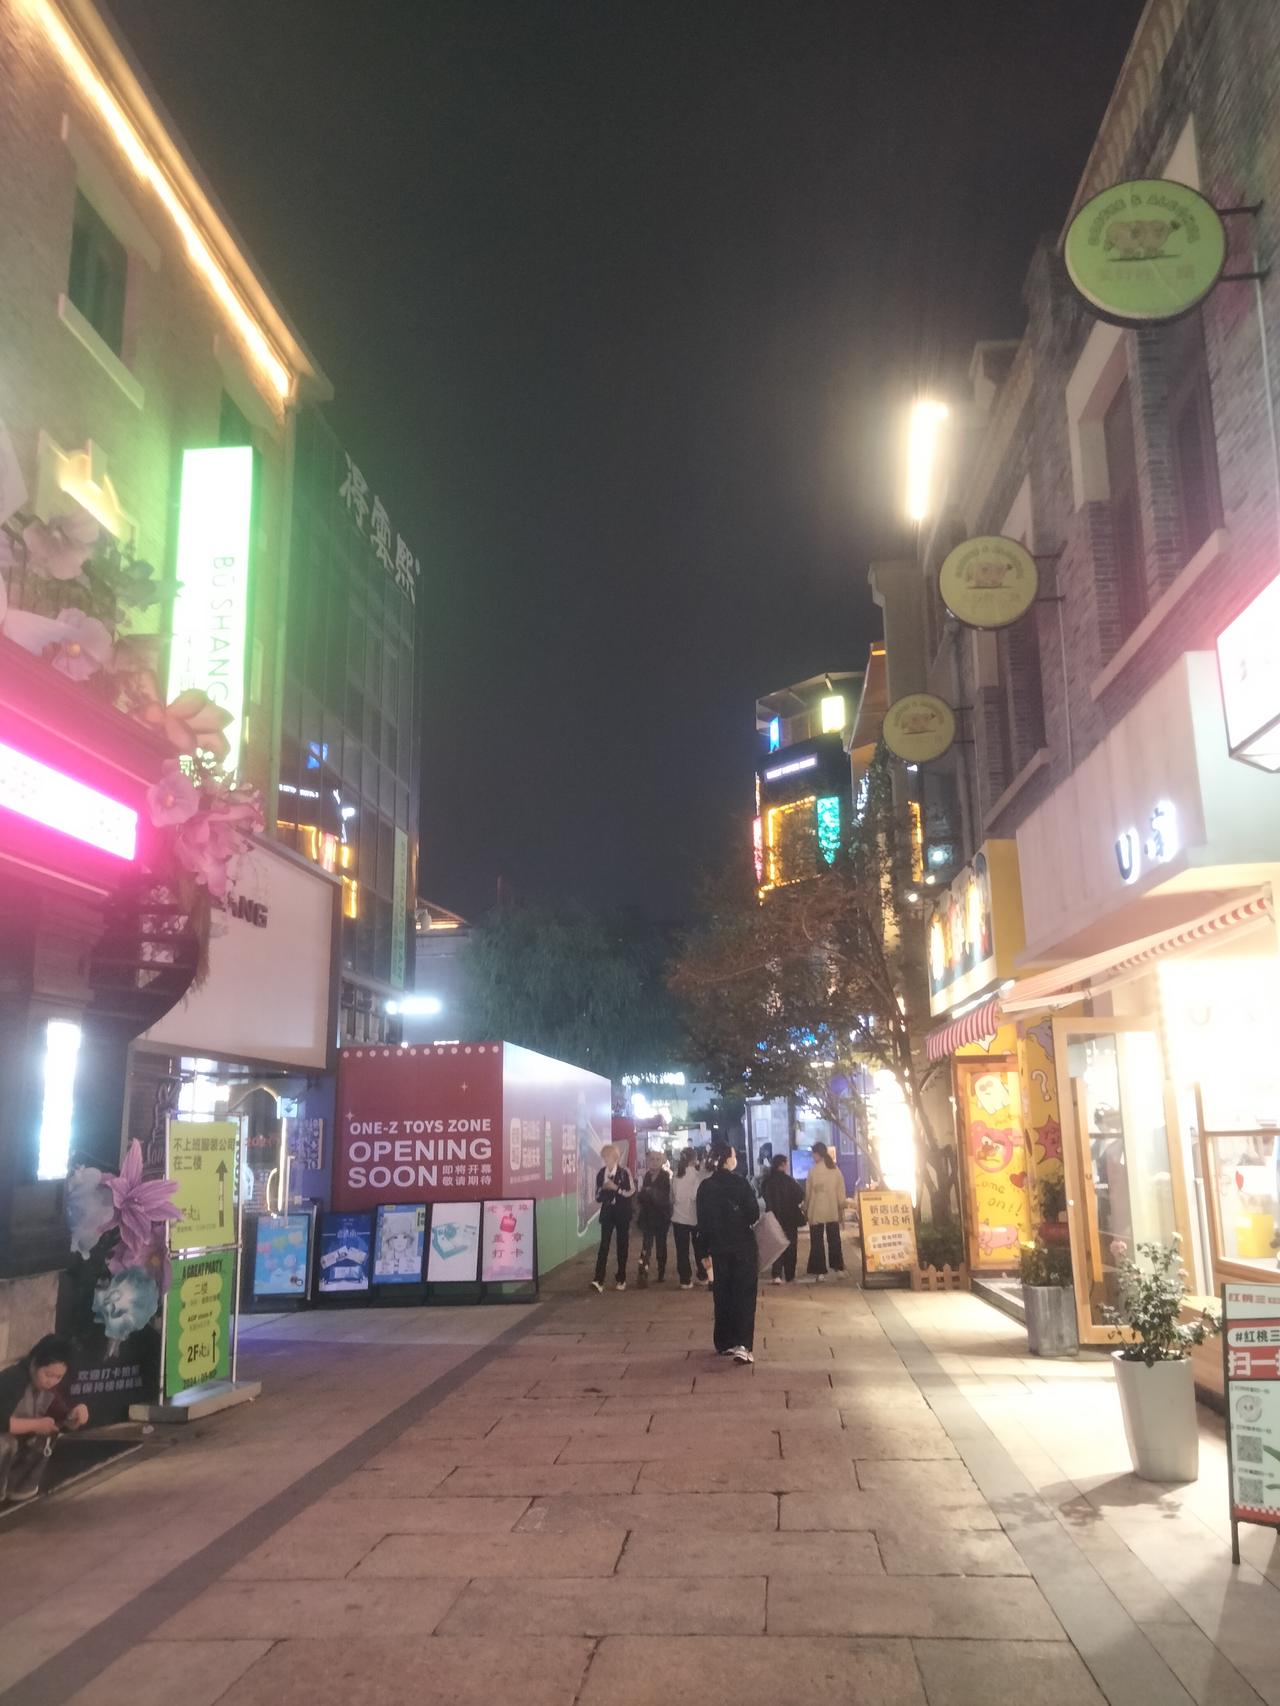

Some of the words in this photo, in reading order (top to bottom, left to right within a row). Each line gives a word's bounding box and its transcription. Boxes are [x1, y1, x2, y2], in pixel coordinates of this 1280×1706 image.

[350, 1121, 398, 1135] ONE-Z
[404, 1120, 443, 1133] TOYS
[448, 1119, 491, 1132] ZONE
[349, 1138, 492, 1163] OPENING
[348, 1166, 438, 1188] SOON
[442, 1164, 492, 1174] 即将开幕
[442, 1175, 491, 1186] 敬请期待
